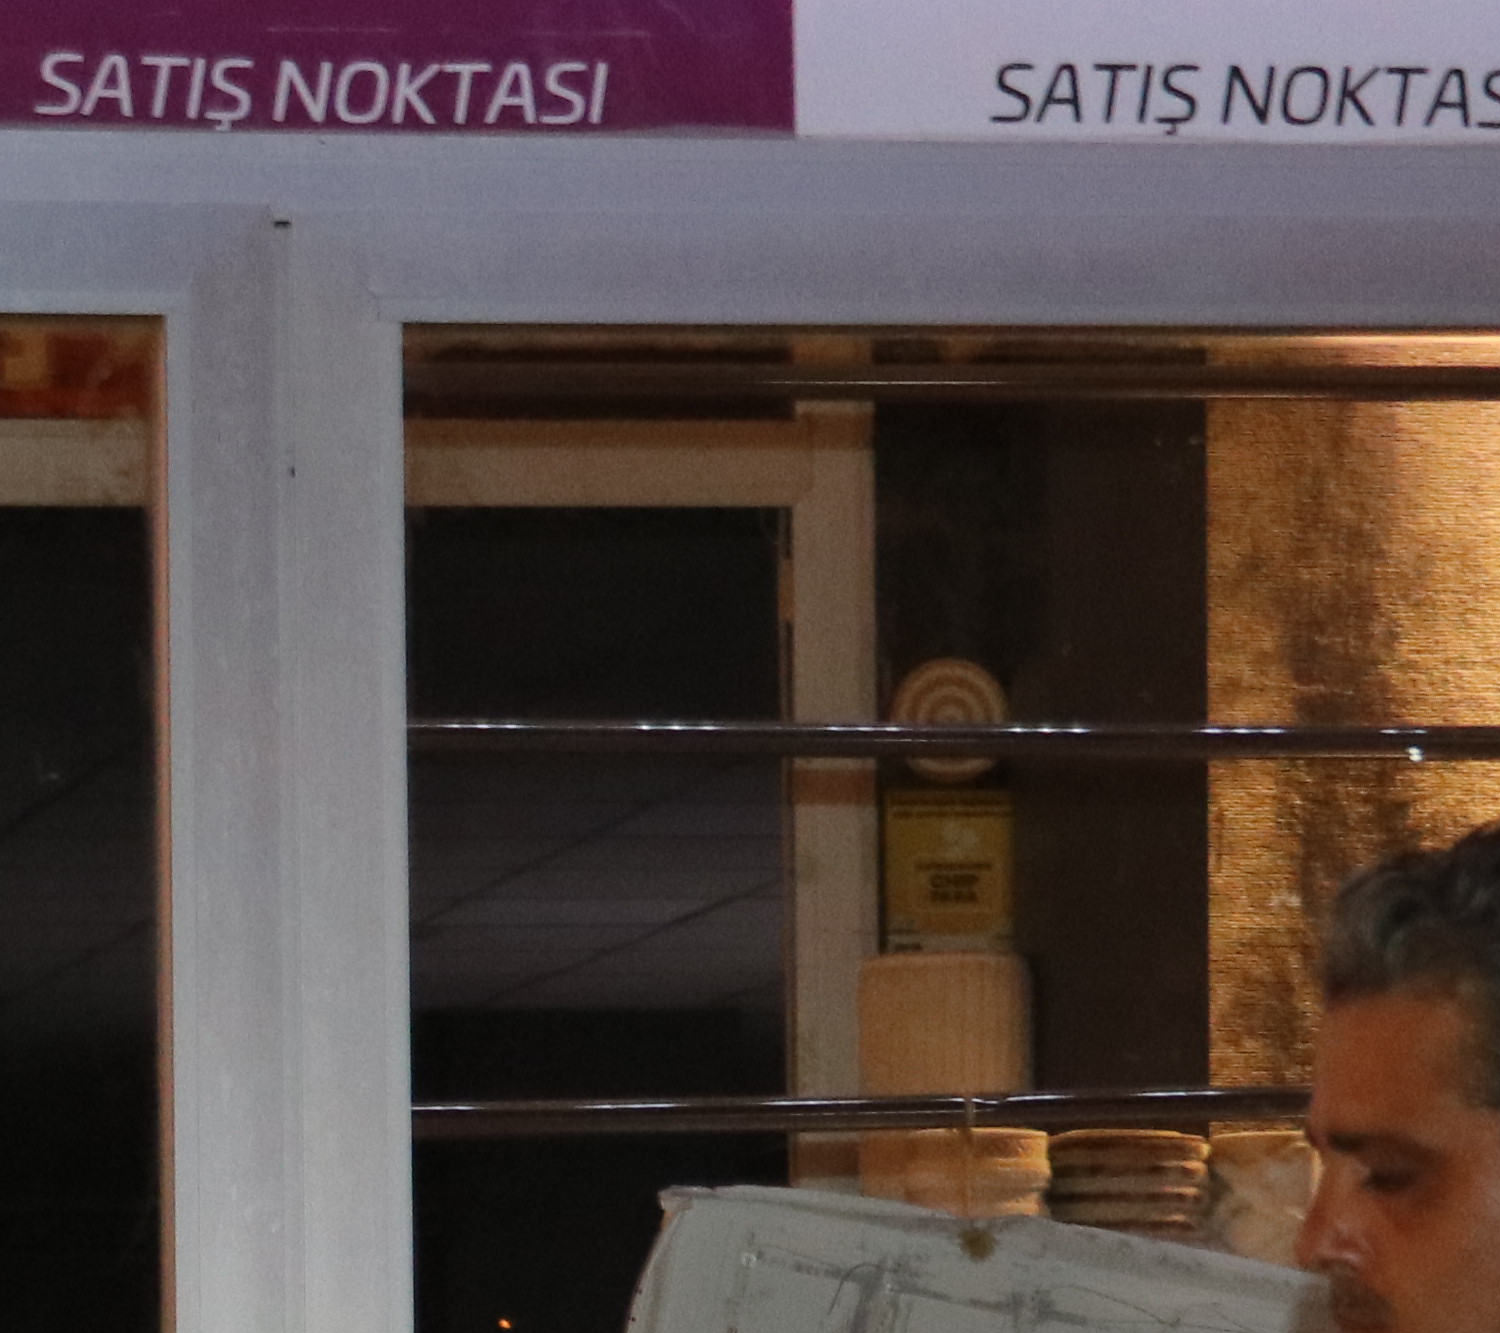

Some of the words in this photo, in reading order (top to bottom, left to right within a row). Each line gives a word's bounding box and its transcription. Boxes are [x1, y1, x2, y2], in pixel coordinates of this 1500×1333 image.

[34, 52, 253, 130] SATIŞ
[273, 59, 609, 126] NOKTASI
[991, 62, 1200, 136] SATIŞ
